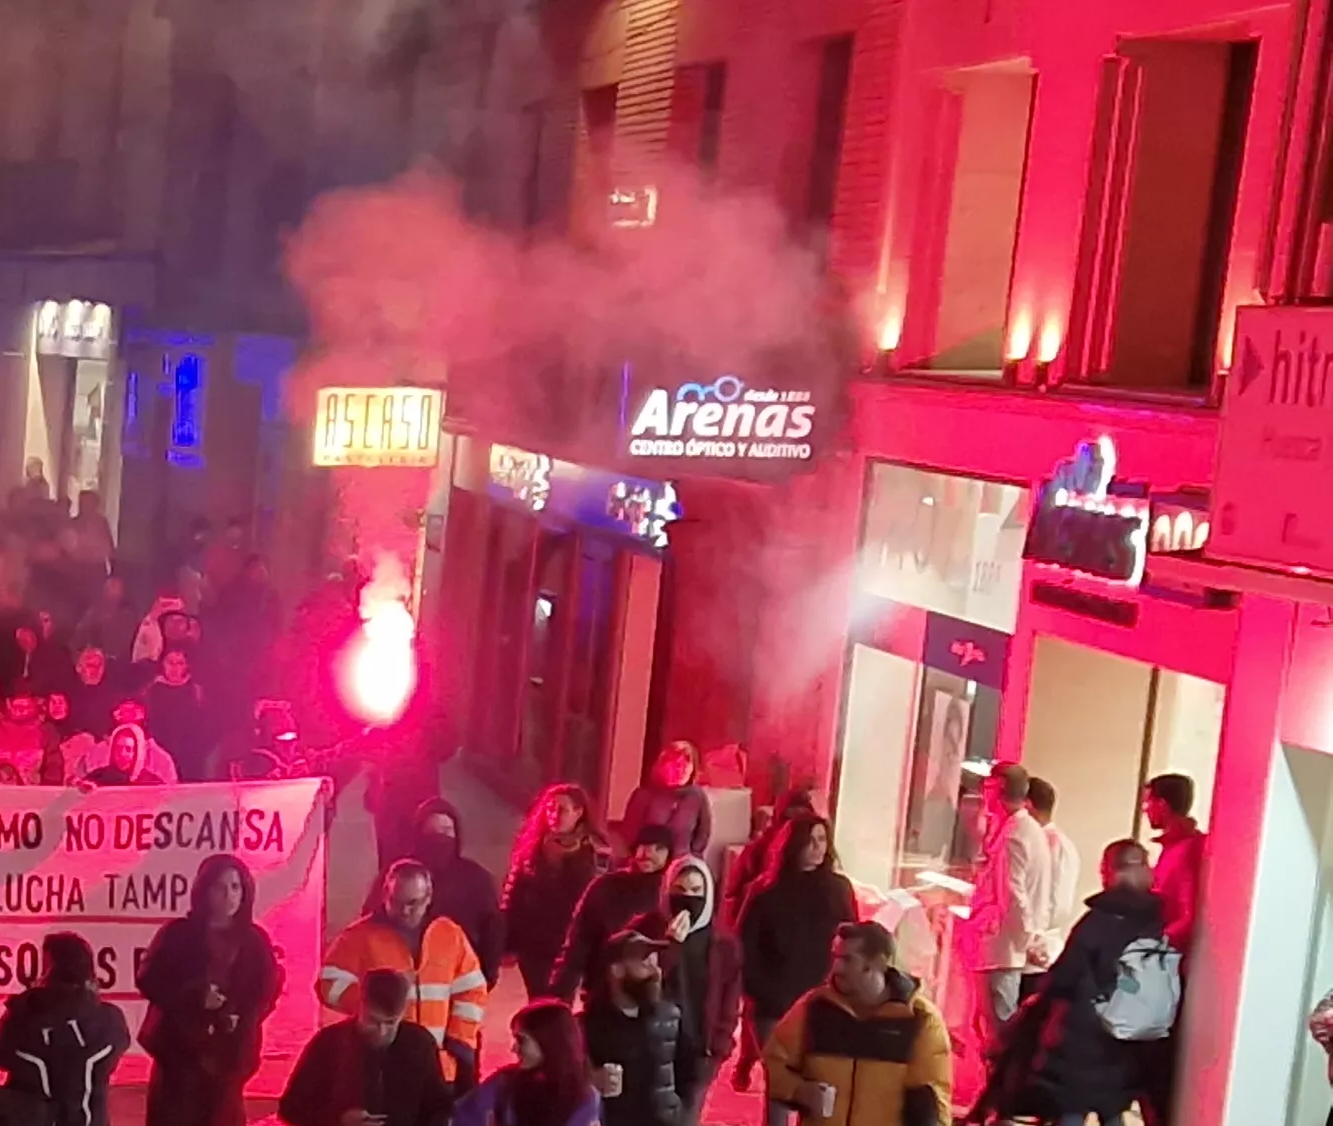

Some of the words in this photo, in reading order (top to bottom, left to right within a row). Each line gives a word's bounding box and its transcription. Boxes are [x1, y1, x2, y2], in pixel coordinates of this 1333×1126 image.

[325, 393, 434, 450] ASCASO
[632, 388, 816, 438] Arenas
[629, 439, 683, 456] CENTRO
[685, 437, 735, 458] ÓPTICO
[737, 443, 748, 458] Y
[748, 443, 811, 459] AUDITIVO
[66, 812, 105, 852] NO
[113, 809, 284, 852] DESCANSA
[103, 873, 189, 912] TAMP
